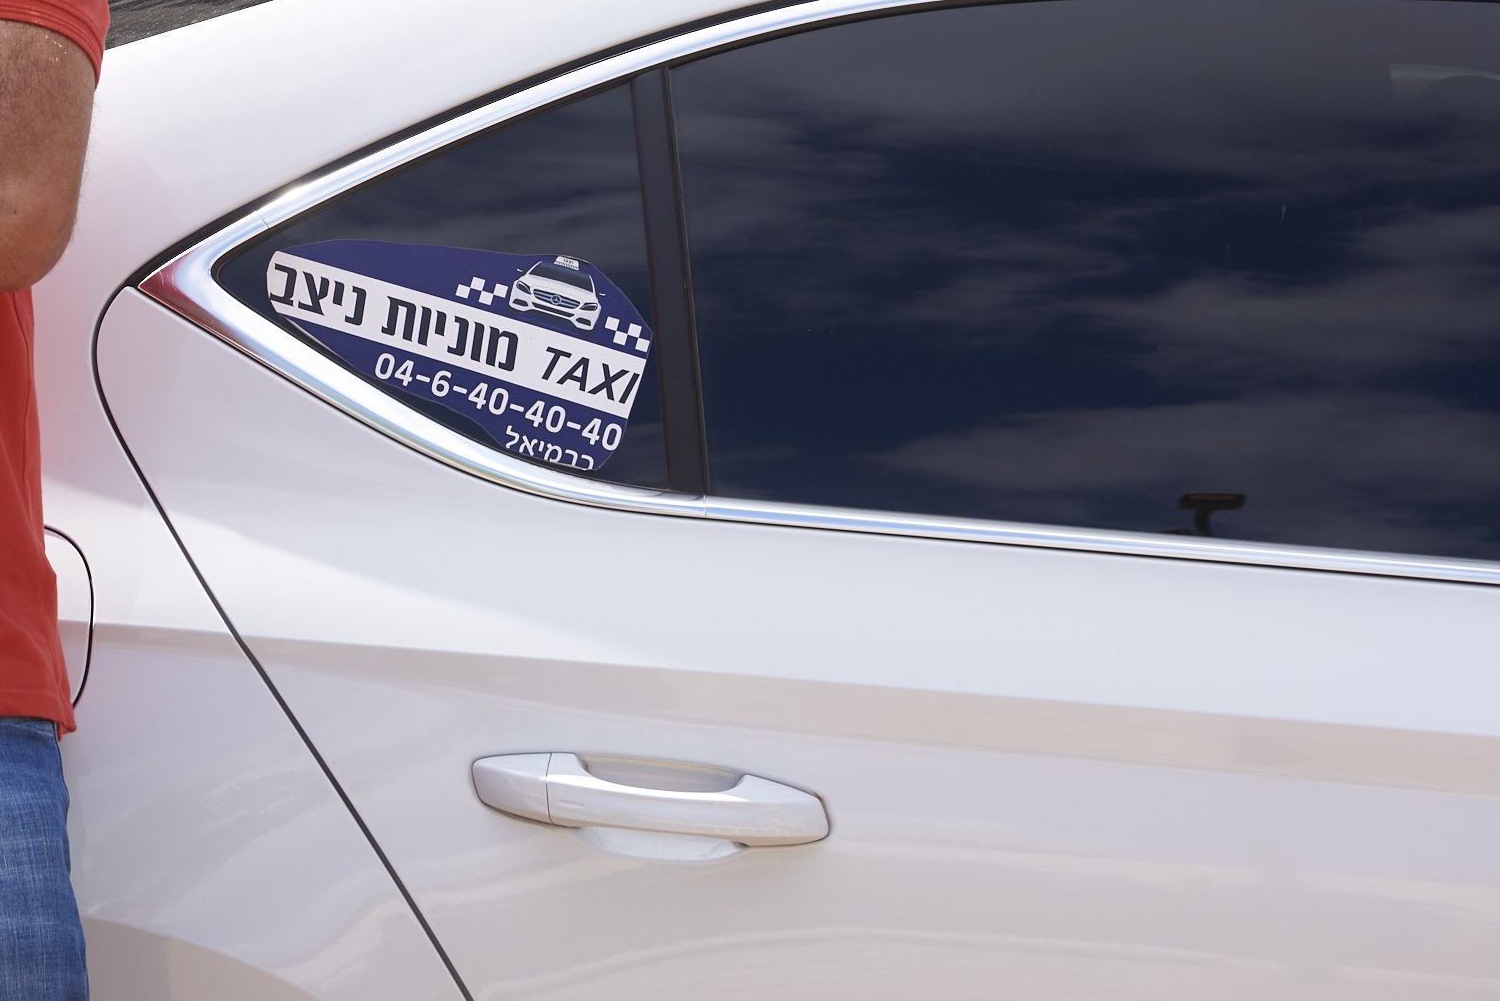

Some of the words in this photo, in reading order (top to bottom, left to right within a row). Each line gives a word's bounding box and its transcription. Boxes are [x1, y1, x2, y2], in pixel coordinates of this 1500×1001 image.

[269, 262, 368, 327] ניצב
[381, 295, 520, 372] מוניות
[374, 351, 623, 452] 04-6-40-40-40
[540, 346, 640, 405] TAXI
[505, 424, 595, 471] כרמיאל
